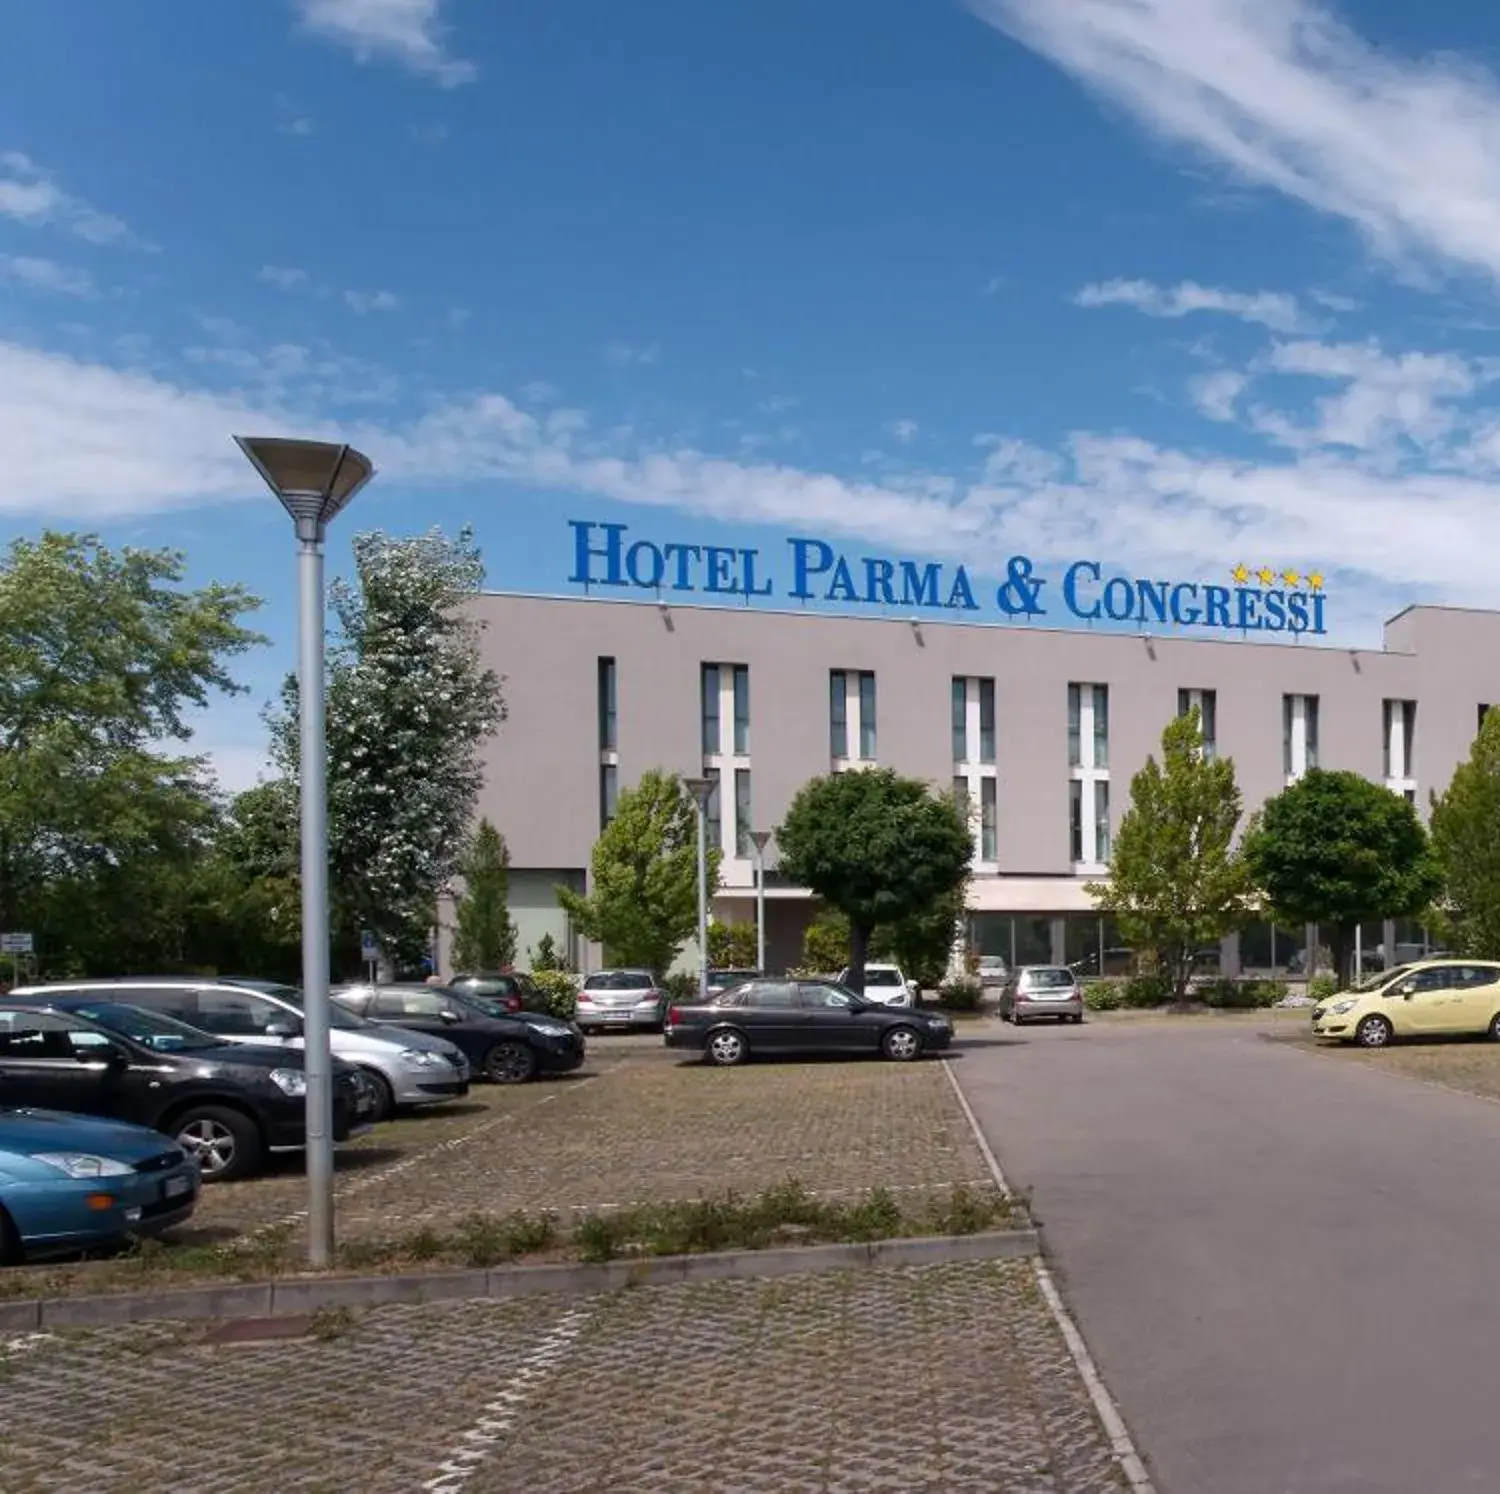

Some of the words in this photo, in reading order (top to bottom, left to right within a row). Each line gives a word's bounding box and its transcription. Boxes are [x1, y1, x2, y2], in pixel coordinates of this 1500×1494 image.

[568, 520, 773, 595] HOTEL
[787, 537, 980, 609] PARMA
[997, 555, 1047, 615] &
[1063, 560, 1327, 634] CONGRESSI
